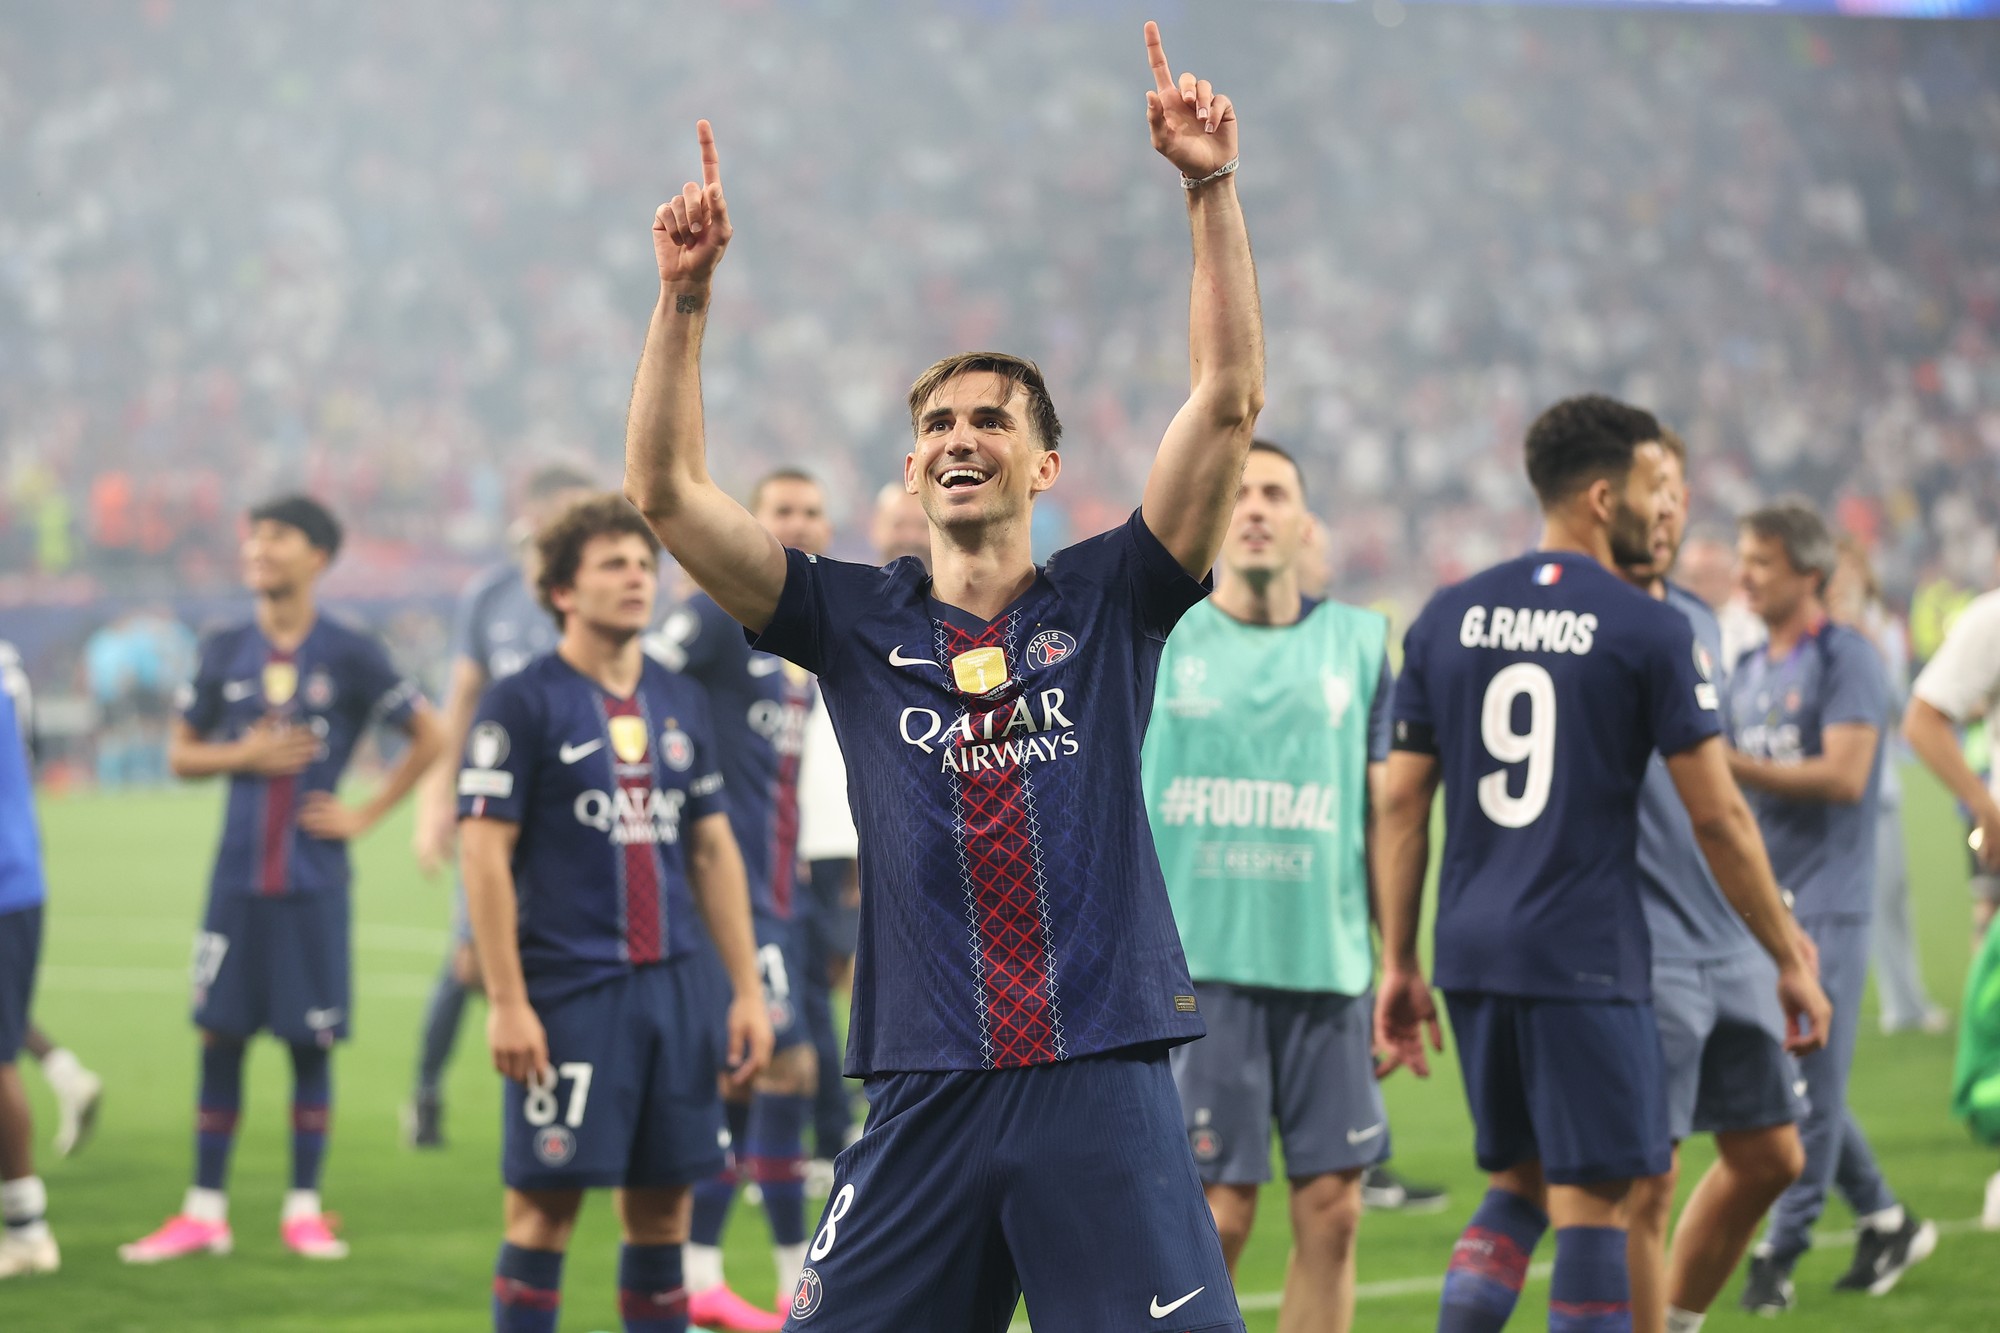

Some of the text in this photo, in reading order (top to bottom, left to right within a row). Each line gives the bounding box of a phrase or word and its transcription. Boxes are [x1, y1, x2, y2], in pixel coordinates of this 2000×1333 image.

[1029, 632, 1059, 653] PARIS
[1460, 605, 1598, 655] G.RAMOS
[941, 731, 1079, 774] AIRWAYS
[1477, 662, 1556, 828] 9
[523, 1061, 594, 1129] 87
[811, 1183, 855, 1261] 8
